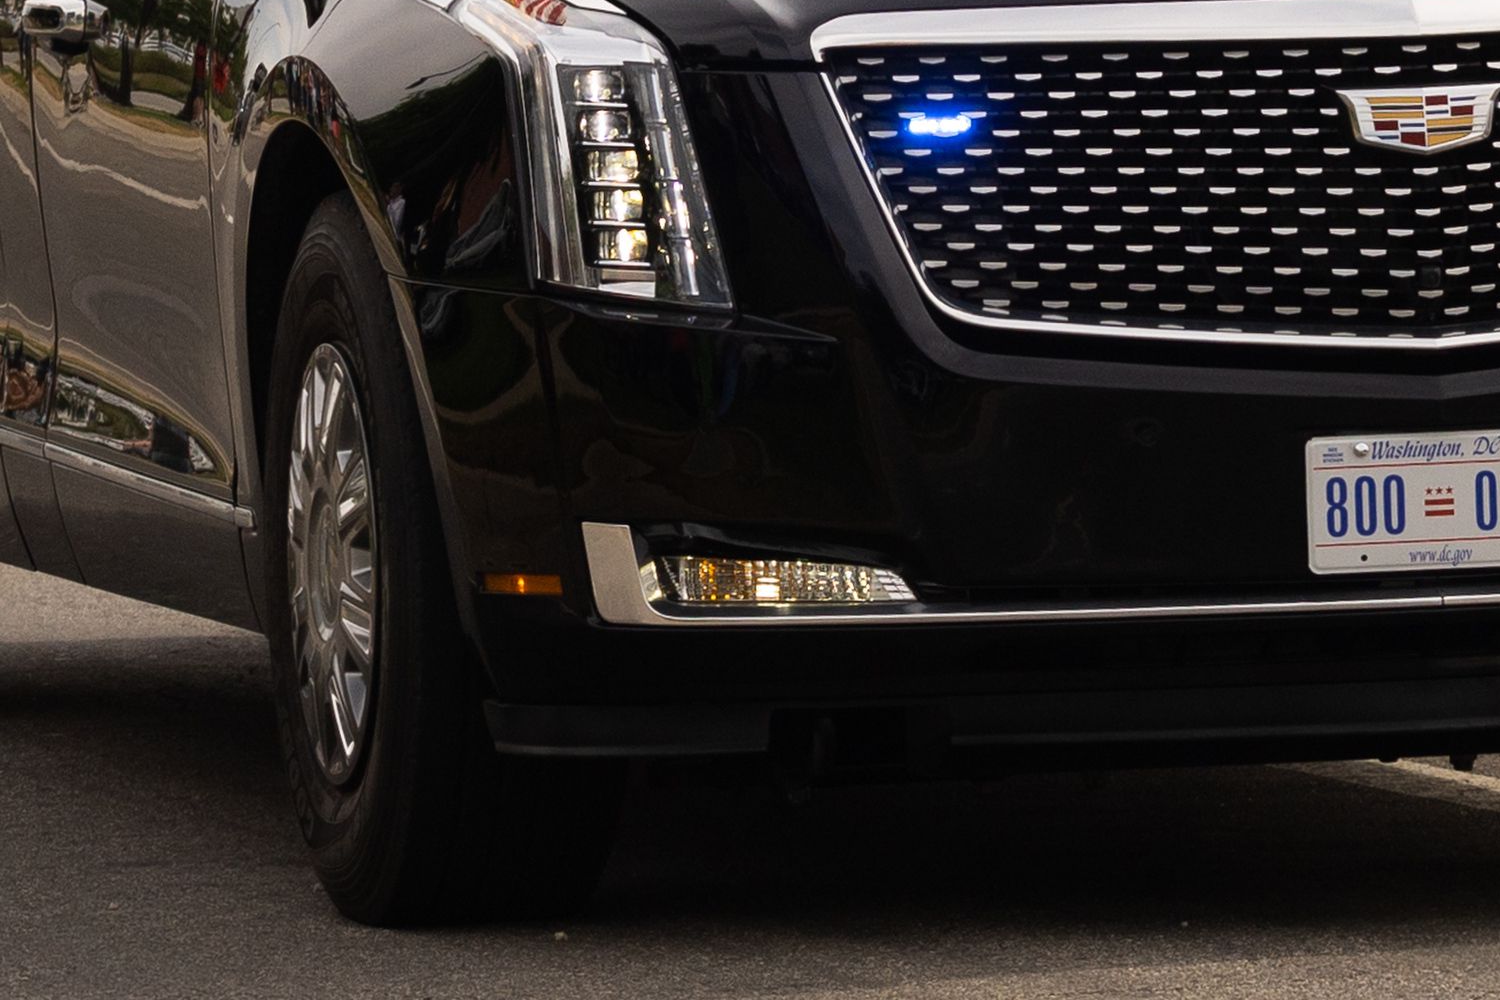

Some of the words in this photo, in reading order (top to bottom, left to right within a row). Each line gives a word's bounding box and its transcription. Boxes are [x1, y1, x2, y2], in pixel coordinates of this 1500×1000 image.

[1371, 440, 1464, 461] Washington,
[1326, 475, 1406, 537] 800
[1409, 545, 1473, 566] www.dc.gov
